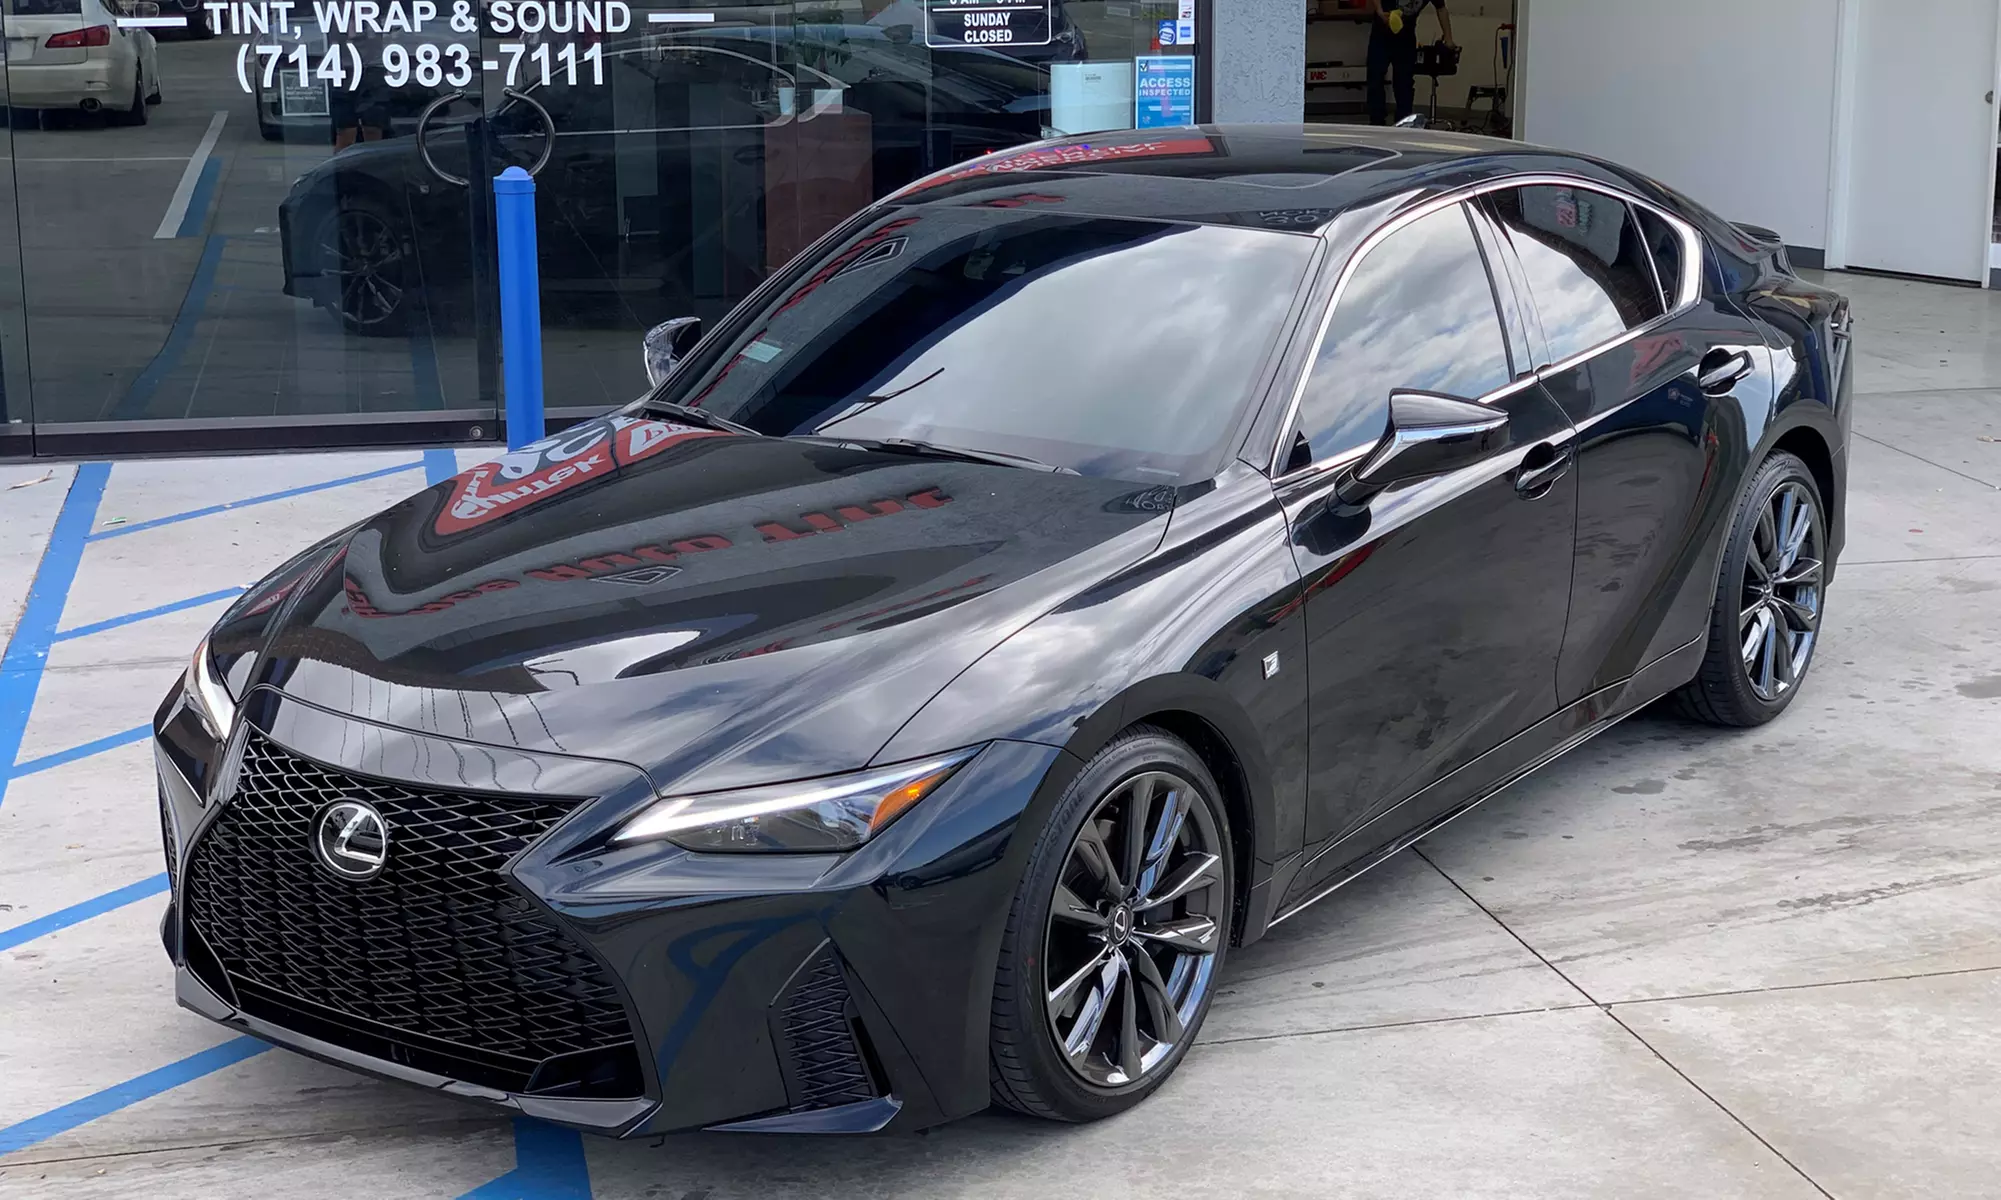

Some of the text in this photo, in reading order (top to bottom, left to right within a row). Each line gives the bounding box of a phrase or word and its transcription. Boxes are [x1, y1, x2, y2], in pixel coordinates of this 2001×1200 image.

[204, 0, 631, 40] TINT, WRAP & SOUND
[963, 12, 1012, 28] SUNDAY
[964, 29, 1014, 44] CLOSED
[237, 43, 364, 93] (714)
[1139, 77, 1191, 89] ACCESS
[1138, 88, 1191, 97] INSPECTED
